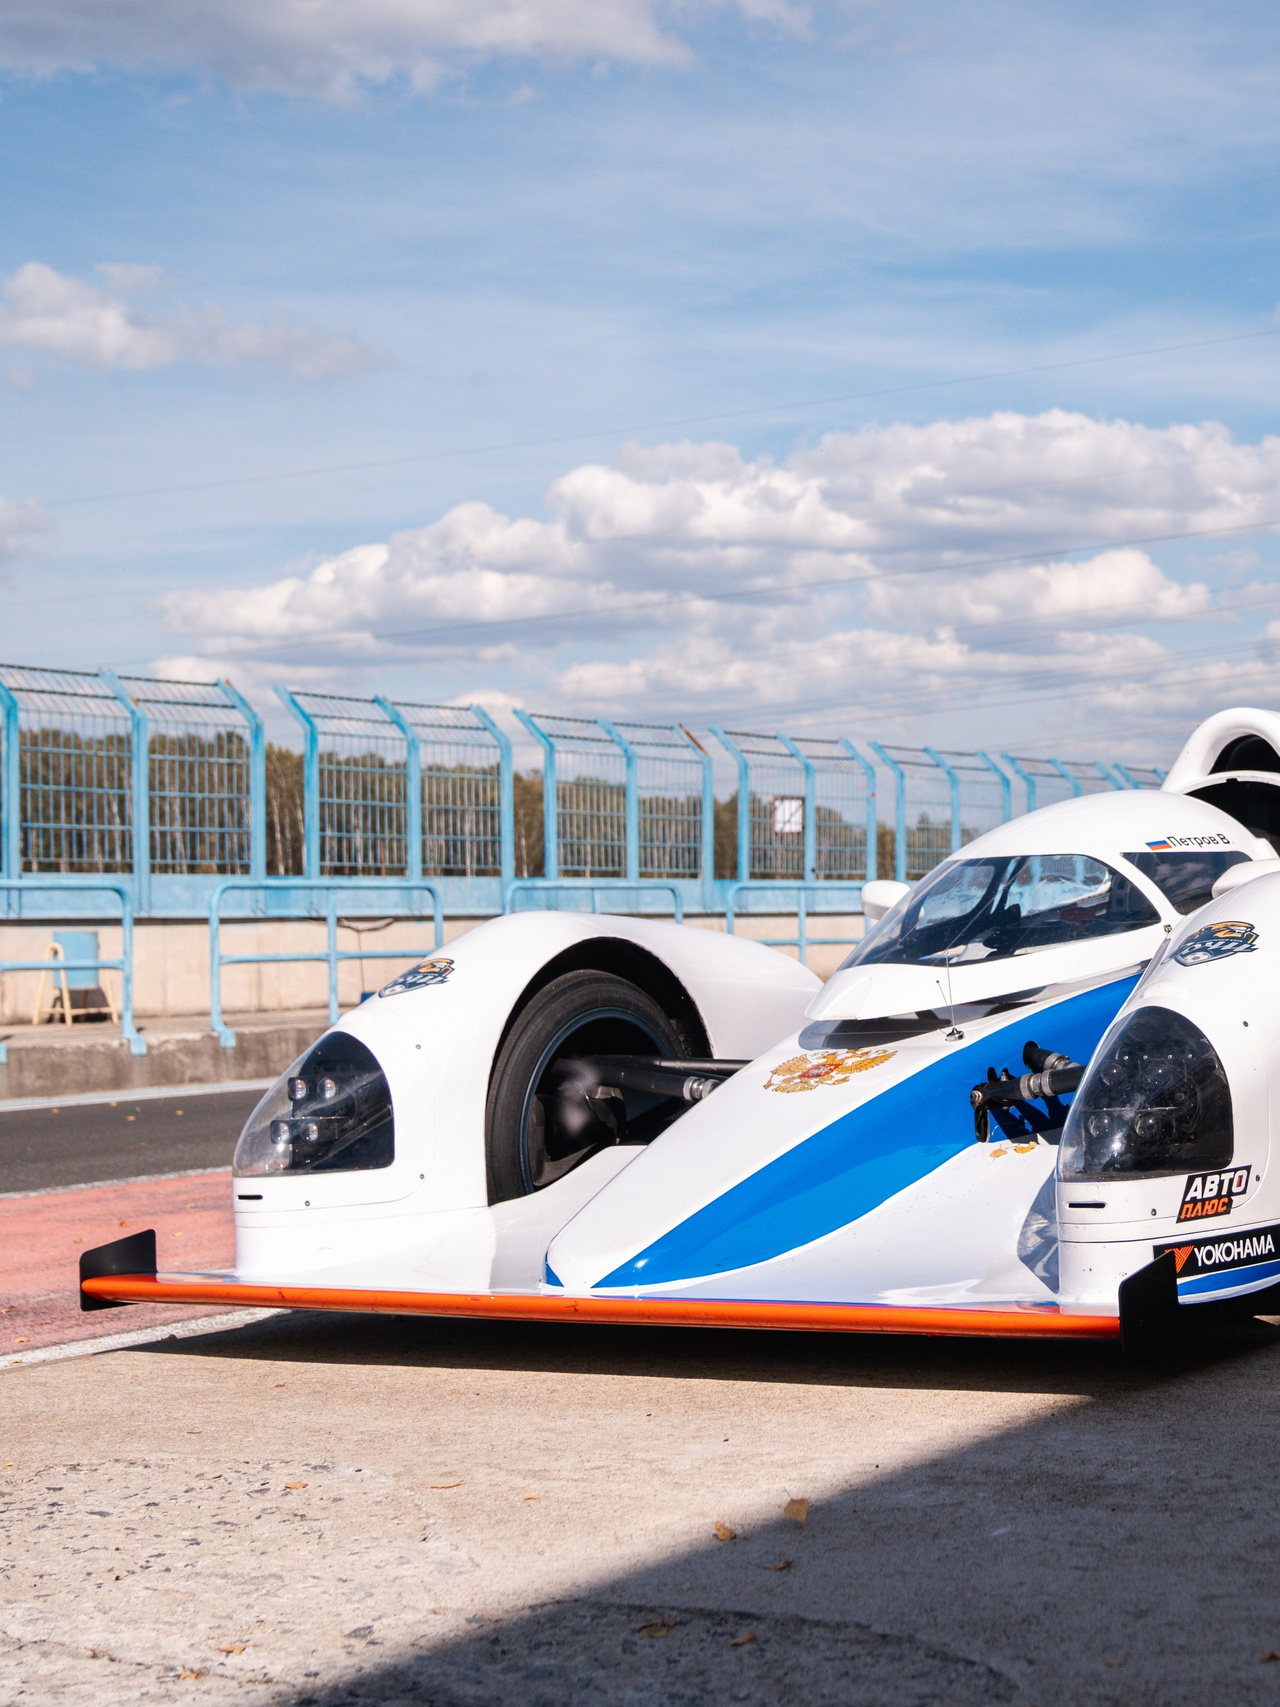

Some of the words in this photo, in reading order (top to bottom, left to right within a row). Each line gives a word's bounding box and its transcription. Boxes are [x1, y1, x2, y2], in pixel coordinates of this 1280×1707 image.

[1166, 835, 1219, 848] Петров
[1184, 1169, 1248, 1202] АВТО
[1180, 1197, 1229, 1220] ПЛЮС
[1193, 1234, 1275, 1267] YOKOHAMA
